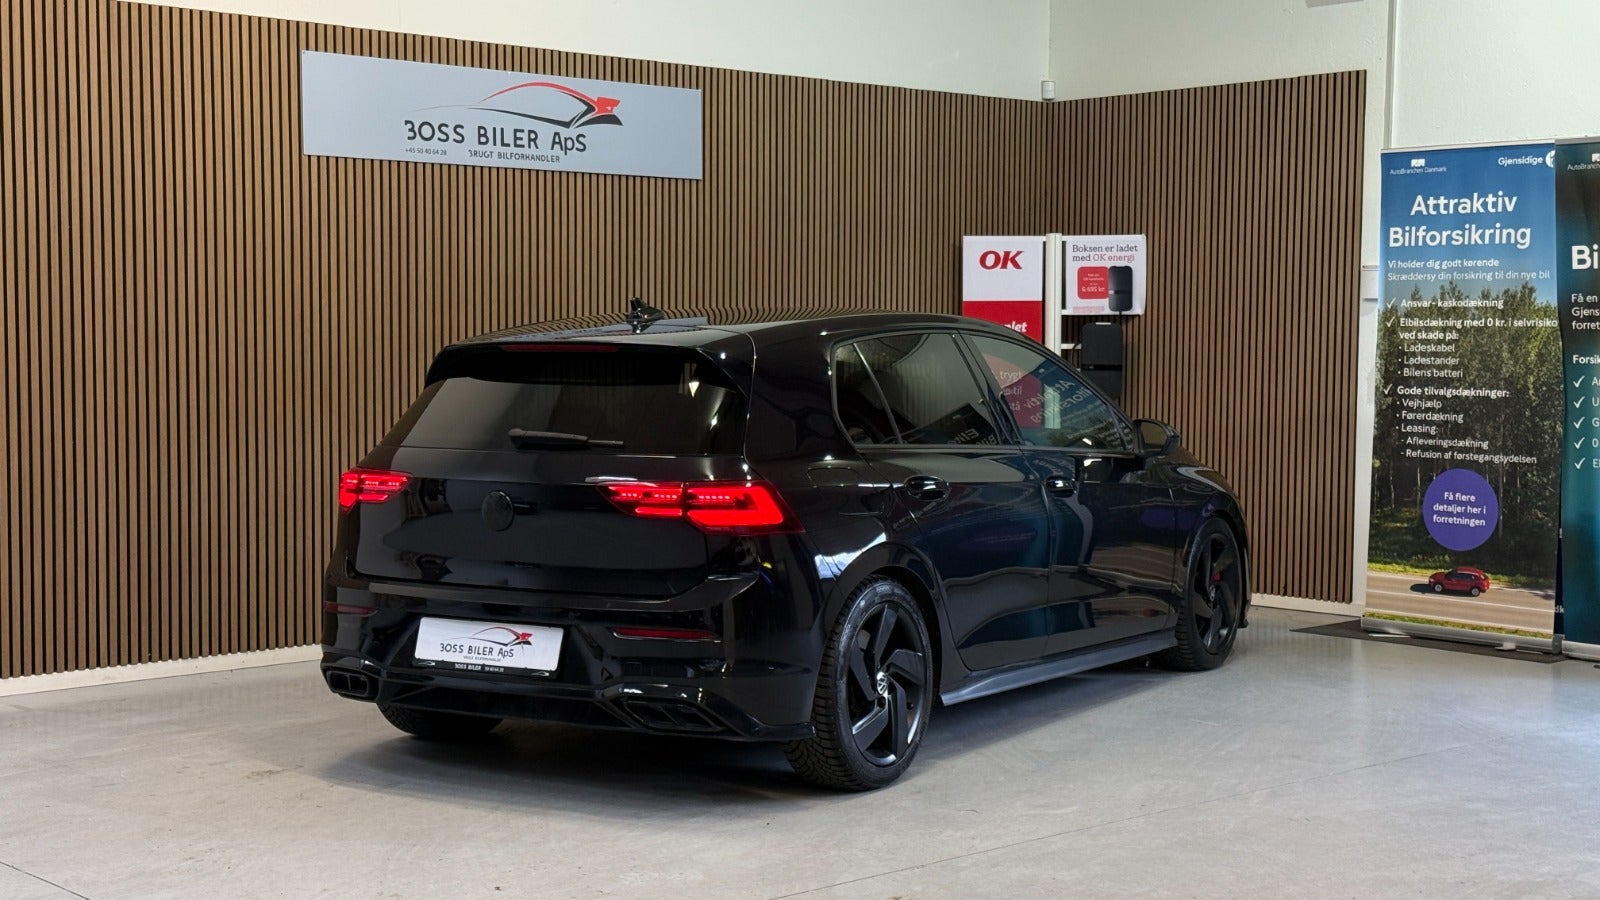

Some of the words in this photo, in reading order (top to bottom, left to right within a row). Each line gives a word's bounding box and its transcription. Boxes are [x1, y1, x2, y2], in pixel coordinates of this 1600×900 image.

[477, 125, 539, 149] BILER
[550, 131, 587, 155] ApS
[497, 150, 560, 163] BILFORHANDLER
[1498, 154, 1543, 168] Gjensidige
[1410, 190, 1518, 216] Attraktiv
[1388, 223, 1531, 250] Bilforsikring
[1072, 244, 1103, 253] Boksen
[1116, 244, 1138, 253] ladet
[979, 250, 1025, 270] OK
[1072, 254, 1091, 262] med
[1092, 254, 1106, 262] OK
[1108, 254, 1135, 263] energi
[1388, 260, 1397, 268] Vi
[1398, 260, 1424, 268] holder
[1426, 259, 1440, 270] dig
[1442, 259, 1462, 270] godt
[1464, 258, 1500, 268] kørende
[1388, 272, 1436, 282] Skræddersy
[1438, 272, 1452, 280] din
[1453, 271, 1493, 282] forsikring
[1494, 271, 1503, 280] til
[1505, 270, 1519, 279] din
[1520, 272, 1536, 282] nye
[1539, 270, 1550, 279] bil
[1438, 299, 1504, 309] kaskodækning
[1571, 293, 1584, 303] Få
[1586, 295, 1598, 303] en
[1400, 319, 1462, 330] Elbilsdækning
[1464, 319, 1485, 328] med
[1486, 320, 1493, 328] 0
[1495, 319, 1507, 328] kr.
[1513, 319, 1558, 328] selvrisiko
[1400, 331, 1415, 340] ved
[1417, 331, 1444, 340] skade
[1446, 330, 1459, 342] på:
[1404, 343, 1455, 352] Ladeskabel
[1404, 356, 1460, 365] Ladestander
[1403, 368, 1432, 377] Bilens
[1434, 368, 1463, 378] batteri
[1397, 386, 1422, 395] Gode
[1424, 387, 1510, 399] tilvalgsdækninger:
[1402, 399, 1442, 409] Vejhjælp
[1402, 411, 1464, 423] Førerdækning
[1402, 424, 1439, 434] Leasing:
[1406, 437, 1489, 450] Afleveringsdækning
[1406, 450, 1442, 458] Refusion
[1444, 451, 1452, 459] af
[1454, 452, 1537, 464] førstegangsydelsen
[1444, 492, 1454, 500] Få
[1456, 492, 1476, 502] flere
[1433, 504, 1465, 514] detaljer
[1467, 505, 1481, 514] her
[1483, 506, 1486, 514] i
[1433, 516, 1486, 528] forretningen
[468, 645, 494, 656] BILER
[498, 648, 514, 658] ApS
